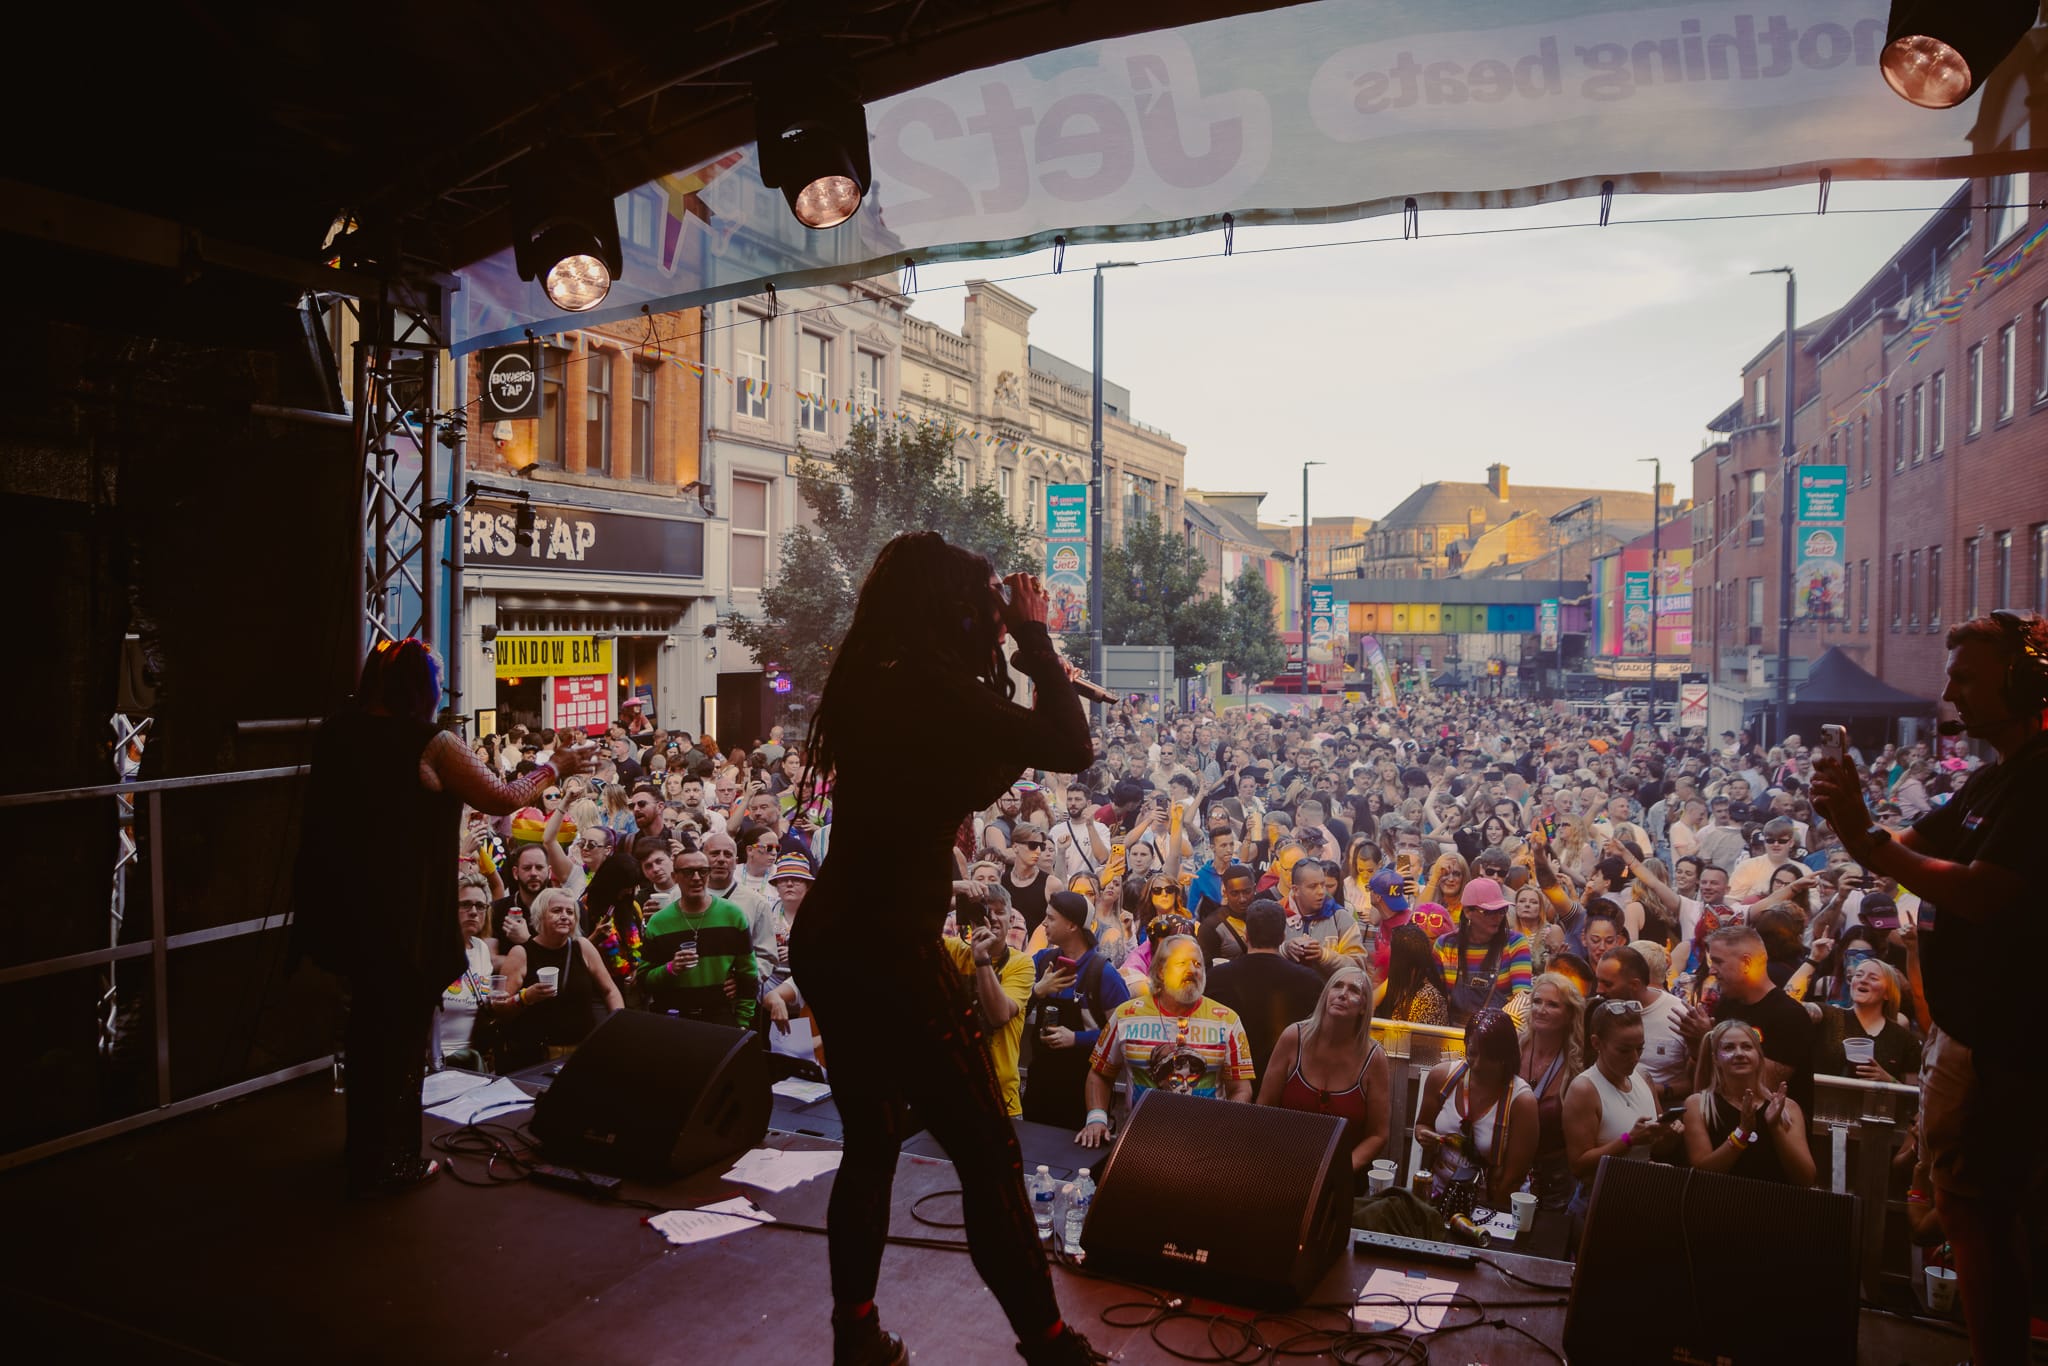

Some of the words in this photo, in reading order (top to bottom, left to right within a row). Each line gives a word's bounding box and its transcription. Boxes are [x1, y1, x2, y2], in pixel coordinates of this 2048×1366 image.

[492, 371, 532, 385] BOWERS
[501, 384, 523, 396] TAP
[530, 516, 596, 561] TAP
[1054, 560, 1078, 569] Jet2
[496, 640, 564, 665] WINDOW
[572, 640, 600, 663] BAR
[1616, 664, 1658, 672] VIADUC
[1125, 1022, 1173, 1040] MORE
[1178, 1024, 1226, 1045] RIDE
